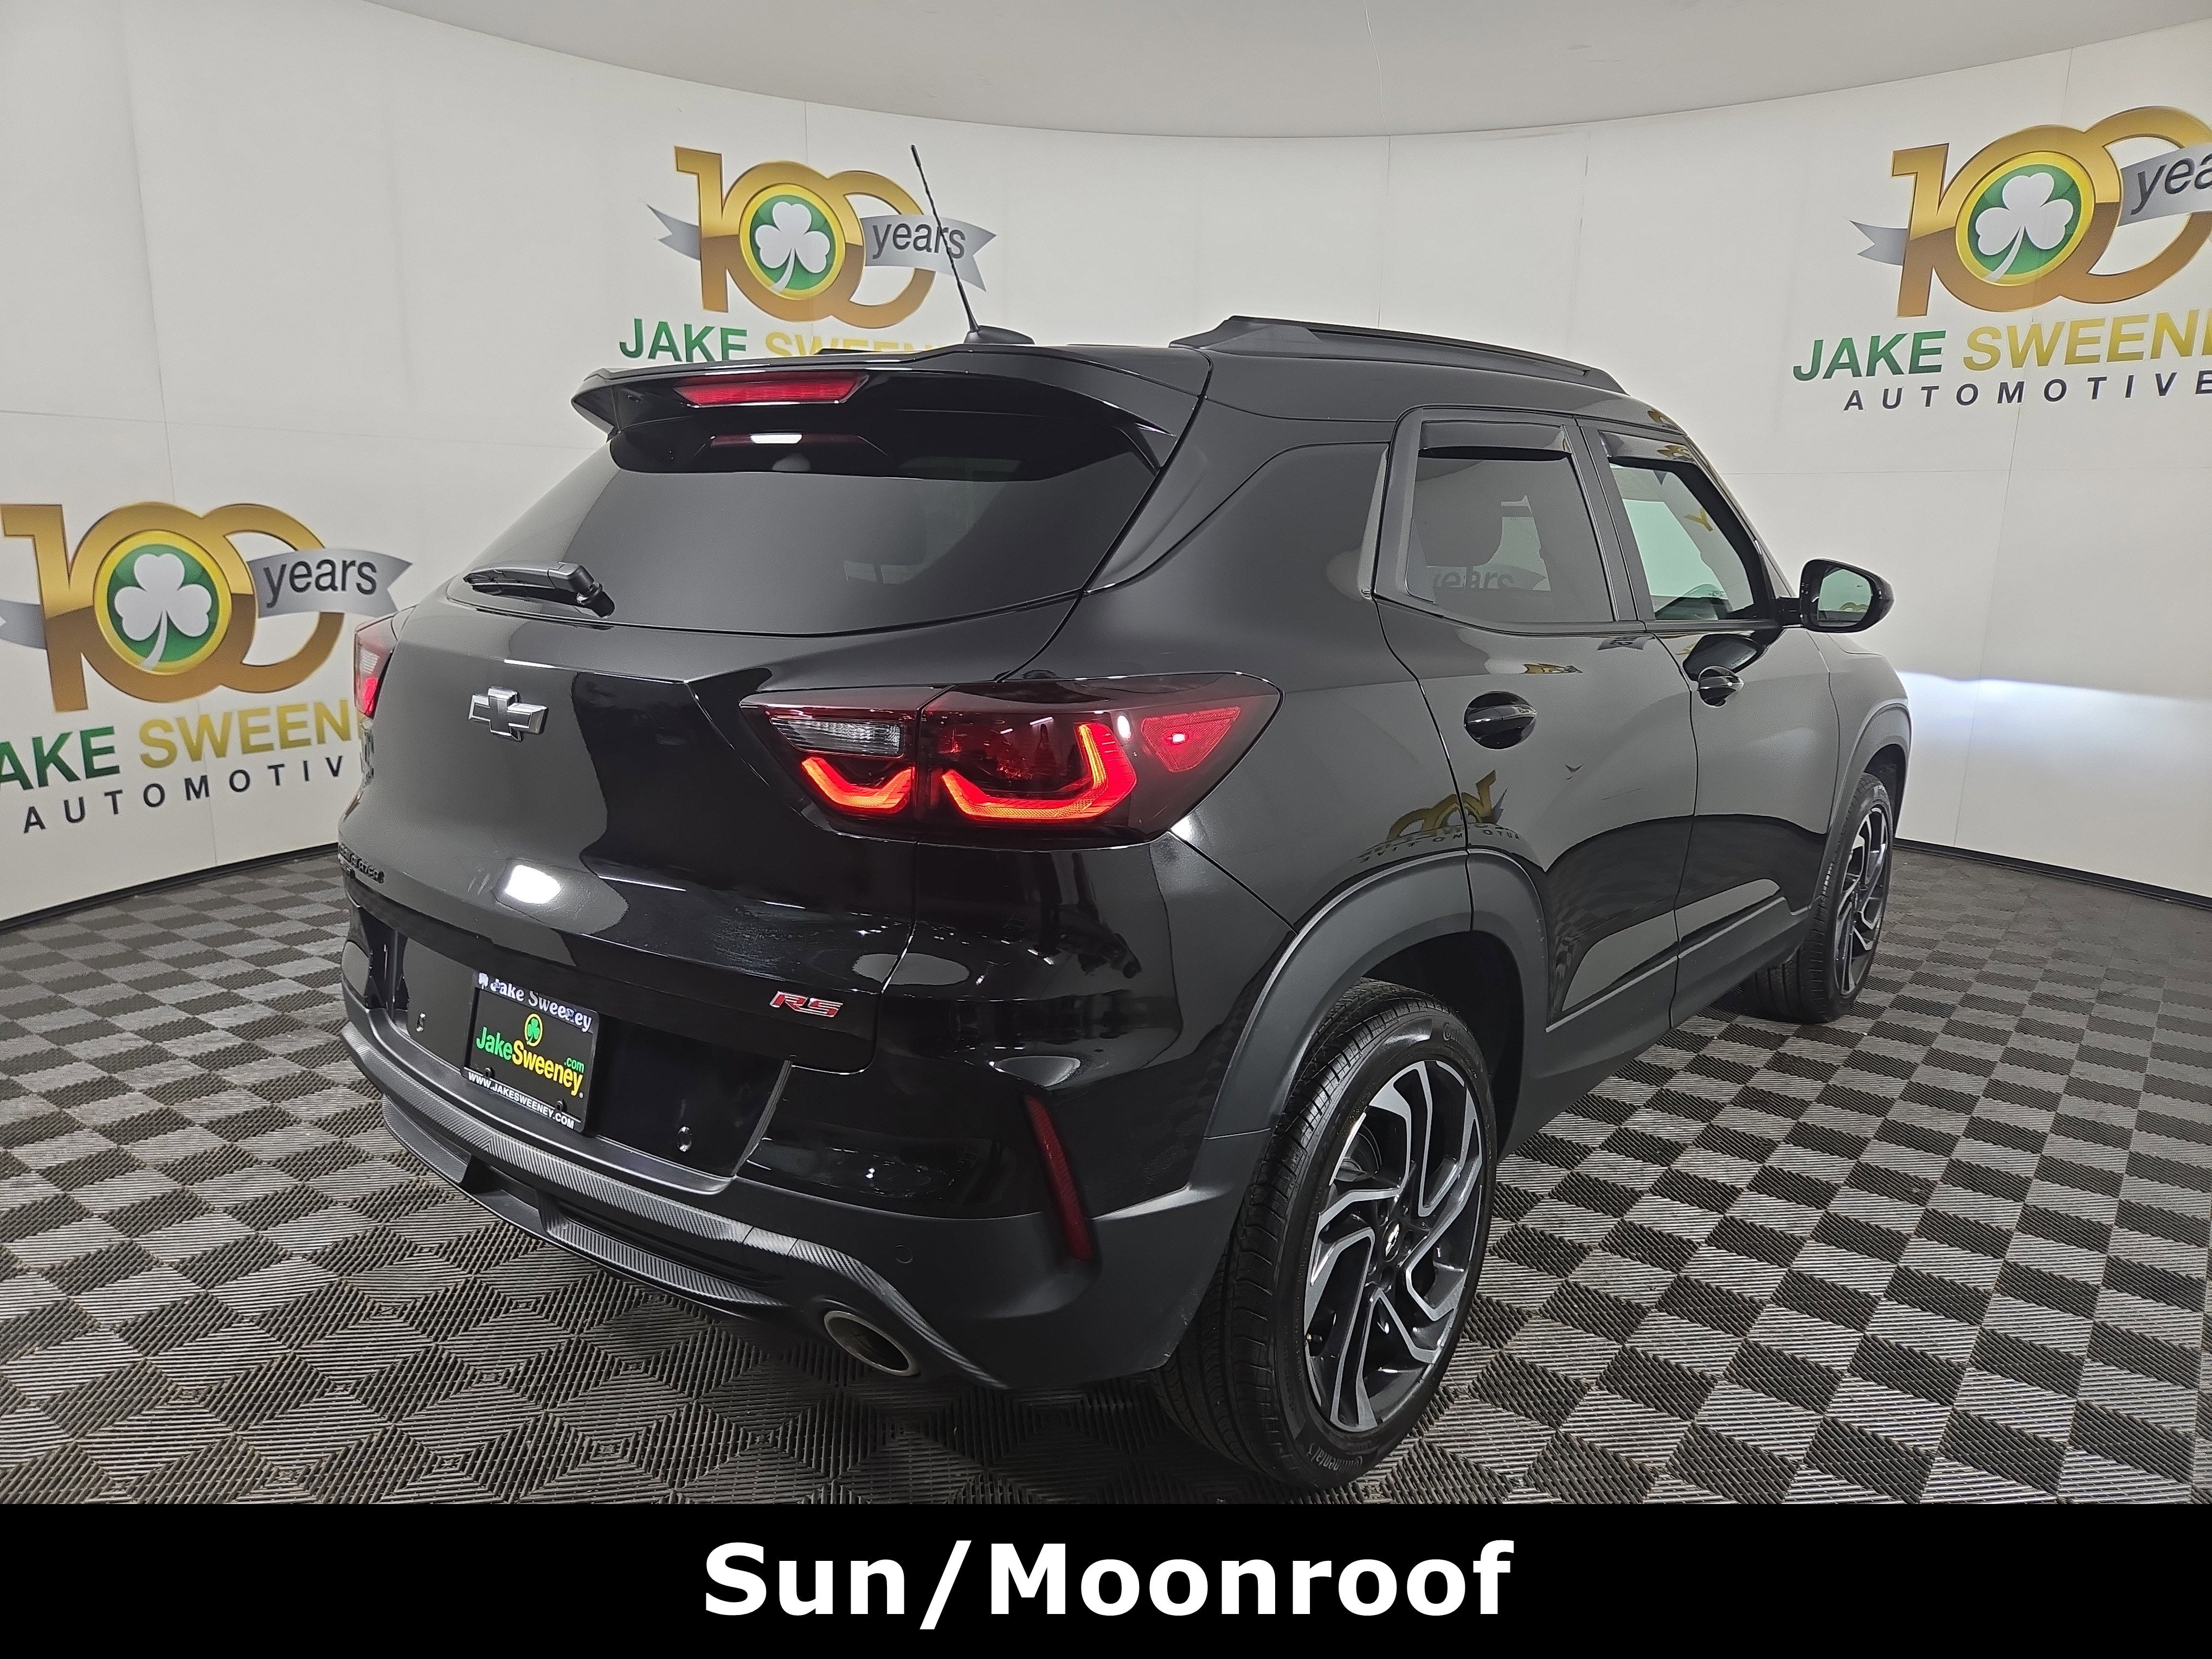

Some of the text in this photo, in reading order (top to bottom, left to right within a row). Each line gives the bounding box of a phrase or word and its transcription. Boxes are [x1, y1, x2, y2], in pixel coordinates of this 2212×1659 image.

[2131, 152, 2212, 215] yea
[674, 145, 937, 329] 100
[872, 221, 967, 259] years
[1793, 308, 2212, 382] JAKE SWEEN
[1843, 369, 2212, 411] AUTOMOTIVE
[263, 558, 378, 608] years
[0, 698, 362, 790] AKE SWEEN
[23, 755, 343, 834] AUTOMOTIV
[490, 978, 592, 1032] Jake Sweeney
[769, 991, 844, 1018] RS
[468, 1071, 575, 1129] WWW.JAKESWEENEY.COM
